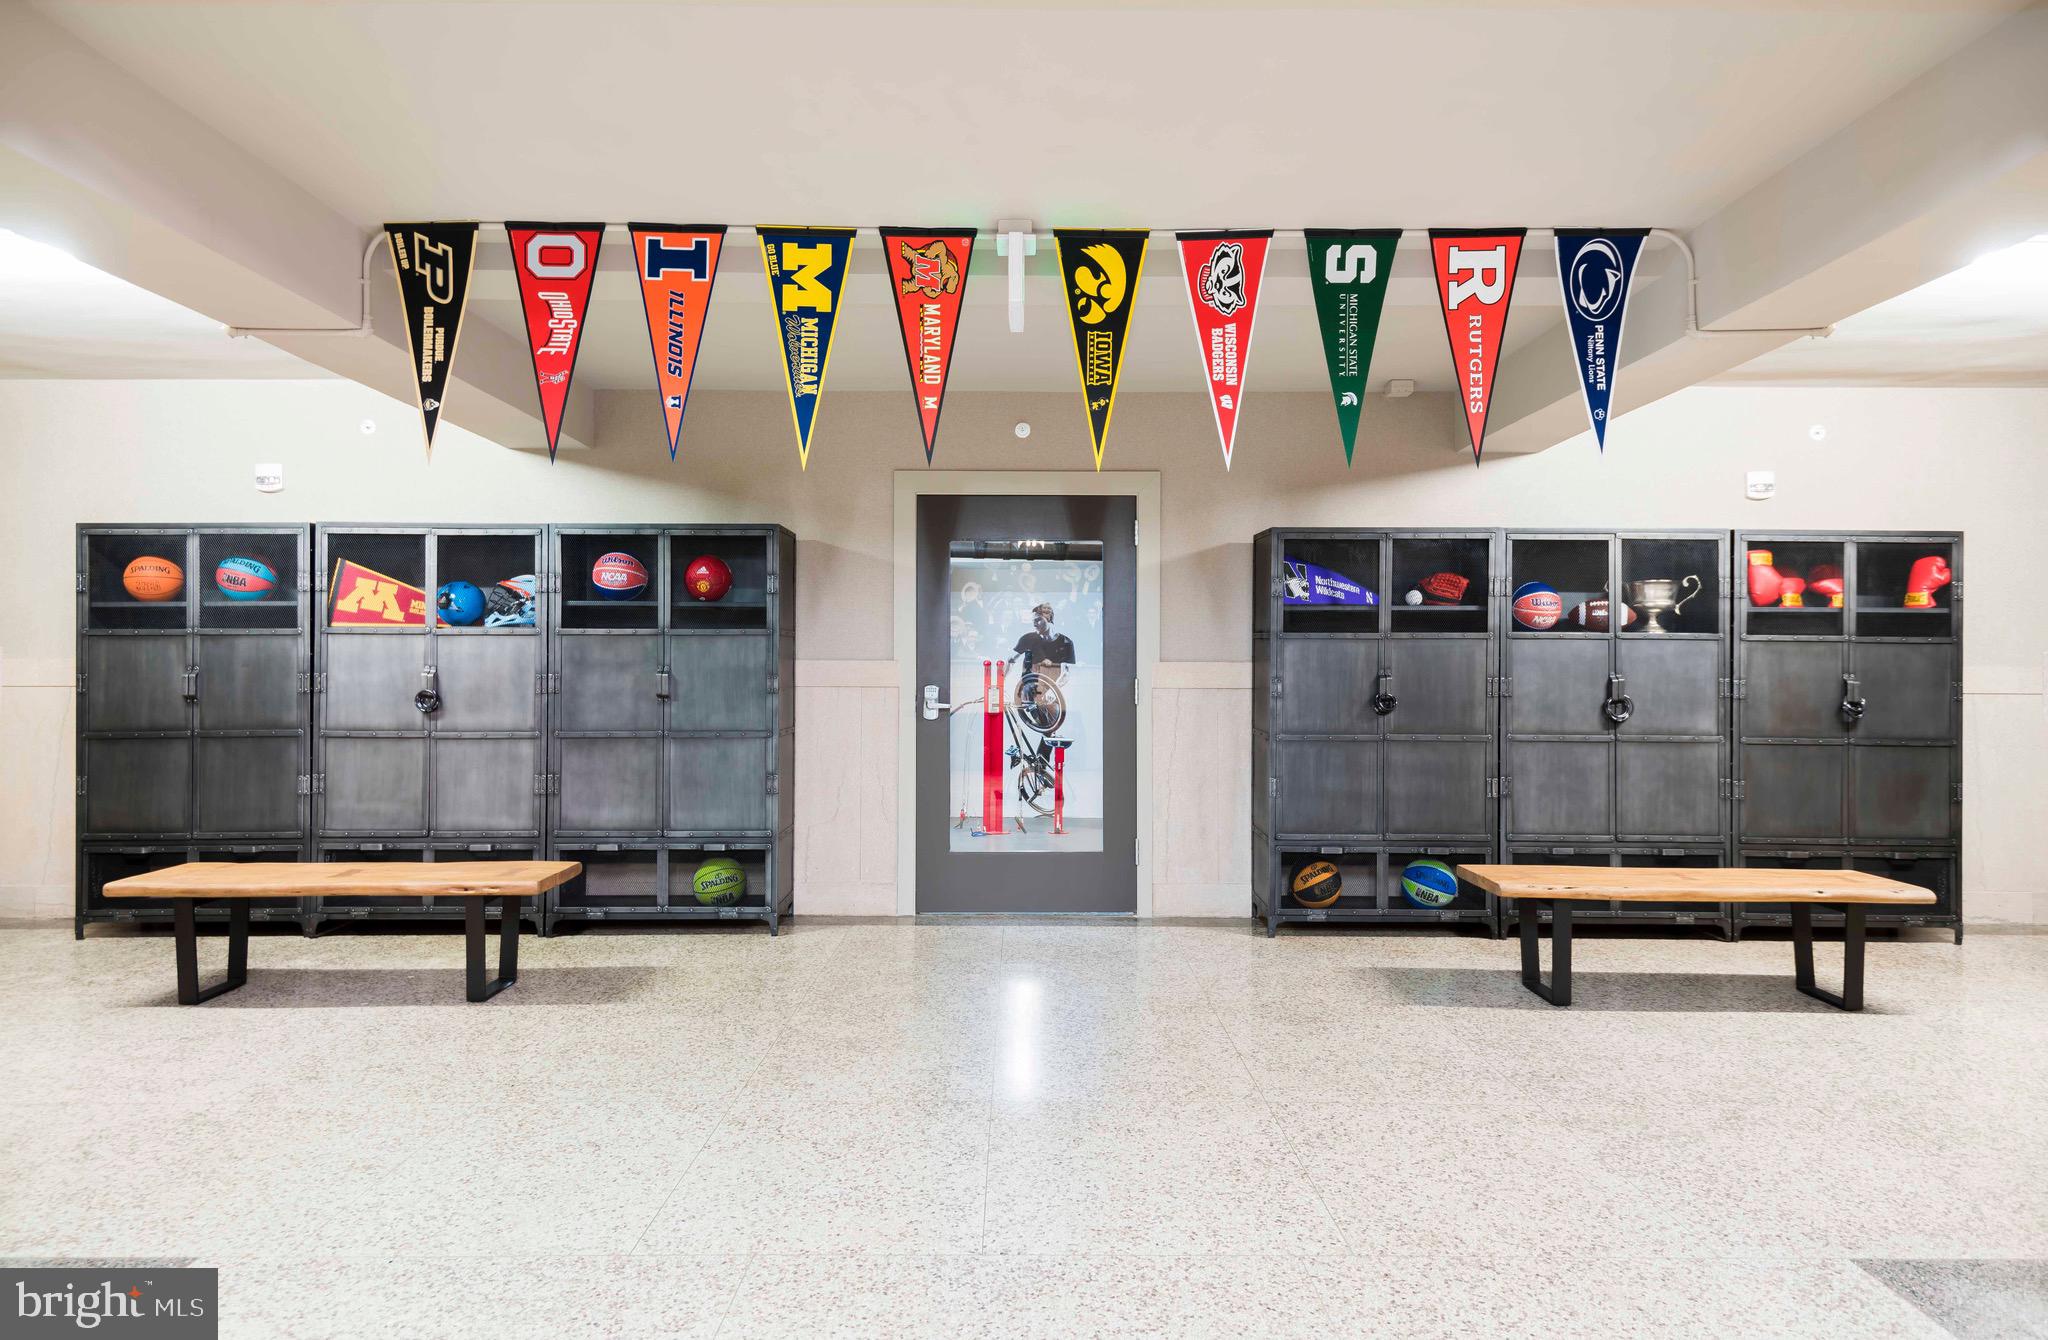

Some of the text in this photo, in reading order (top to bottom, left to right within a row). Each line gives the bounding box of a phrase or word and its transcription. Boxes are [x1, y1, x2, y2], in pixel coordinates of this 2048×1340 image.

[394, 232, 410, 270] BOILER UP
[524, 232, 588, 280] O
[645, 235, 710, 283] I
[766, 243, 780, 276] GO BLUE
[914, 254, 941, 292] M
[1325, 244, 1377, 284] S
[782, 242, 832, 313] M
[1447, 245, 1507, 311] R
[422, 306, 434, 382] BOILERMAKERS
[434, 327, 445, 362] PURDUE
[667, 289, 684, 378] ILLINOIS
[784, 315, 804, 396] Wolverines
[800, 317, 819, 395] MICHIGAN
[923, 304, 941, 385] MARYLAND
[1212, 327, 1224, 382] BADGERS
[1224, 322, 1238, 386] WISCONSIN
[1338, 293, 1346, 377] UNIVERSITY
[1348, 293, 1359, 377] MICHIGAN STATE
[1594, 324, 1606, 391] PENN STATE
[1095, 332, 1112, 384] IOWA
[1469, 314, 1483, 414] RUTGERS
[1586, 335, 1596, 384] Nittany Lions
[924, 396, 938, 409] M
[130, 565, 171, 575] SPALDING
[225, 574, 248, 588] NBA
[601, 571, 628, 582] NCAA
[1315, 575, 1361, 595] Northwestern
[1315, 585, 1345, 600] Wildcats
[336, 576, 406, 622] M
[701, 874, 739, 891] SPALDING
[1420, 890, 1439, 904] NBA
